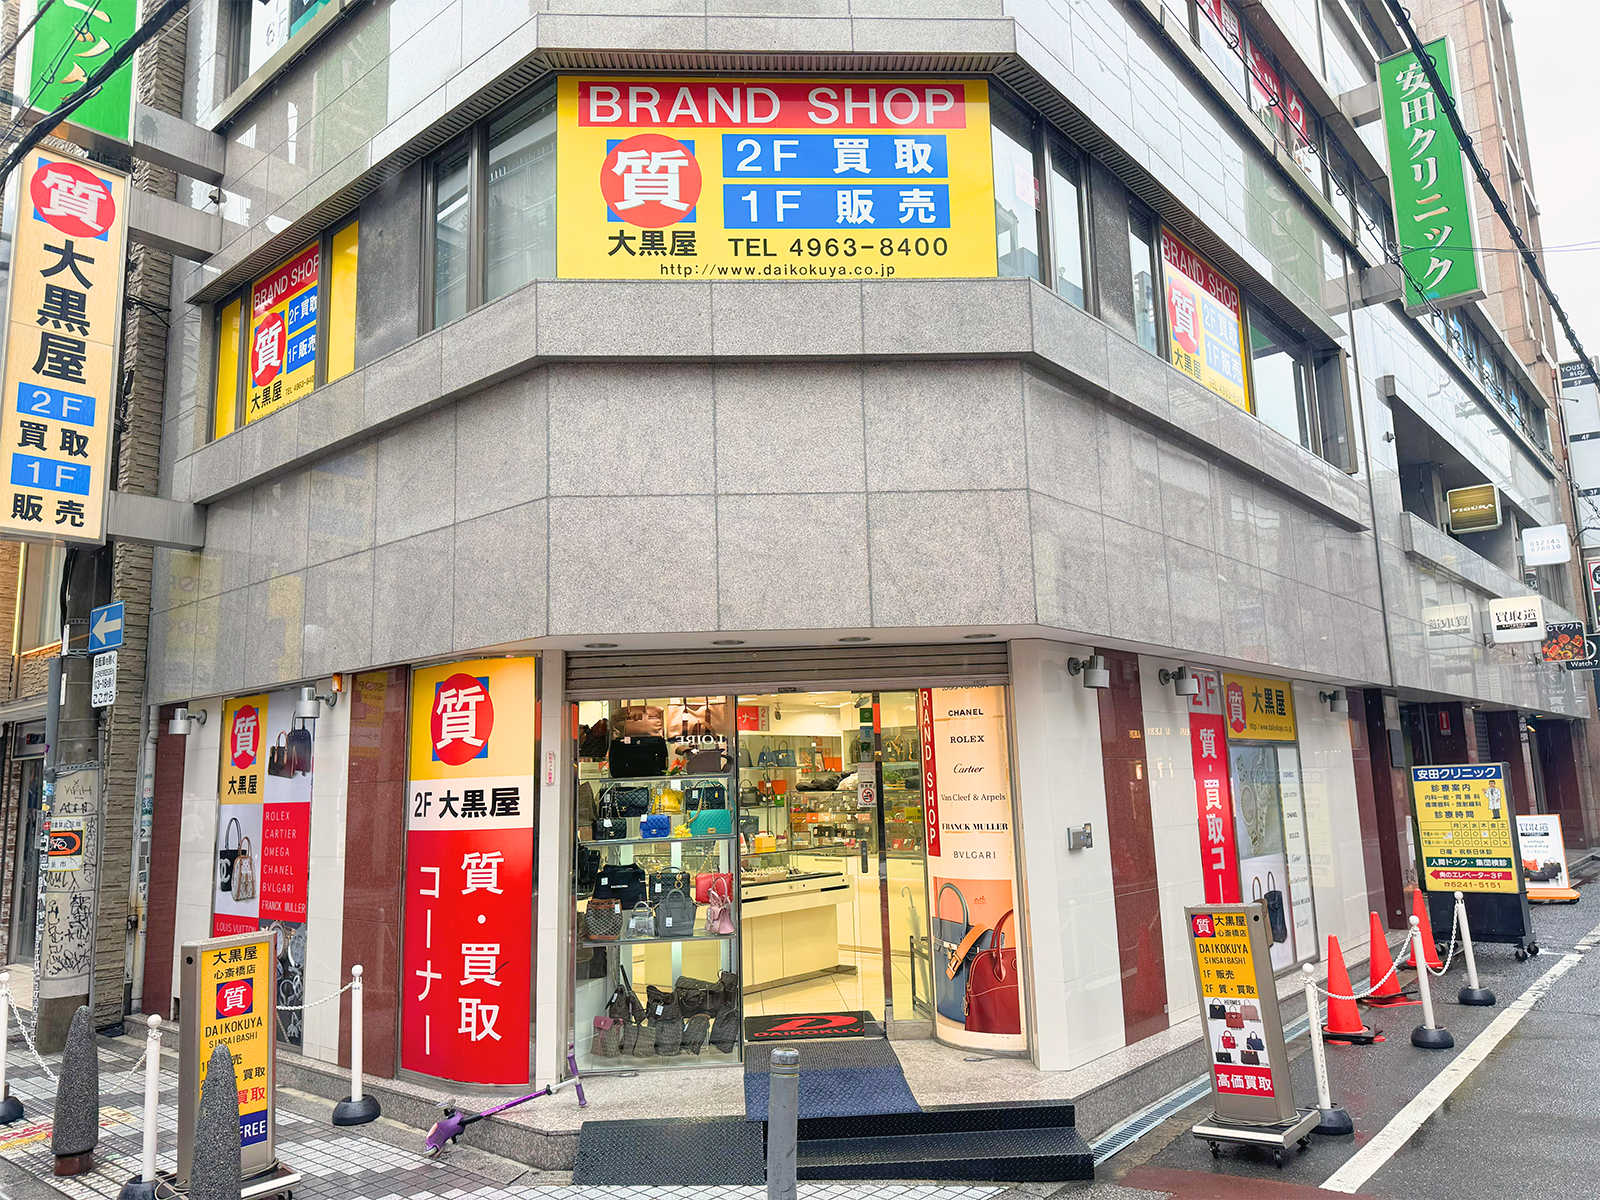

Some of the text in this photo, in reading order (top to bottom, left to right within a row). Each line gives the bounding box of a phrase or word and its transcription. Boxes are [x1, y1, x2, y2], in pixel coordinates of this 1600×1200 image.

[588, 86, 955, 125] BRAND SHOP
[736, 137, 935, 175] 2F 買取
[611, 148, 691, 212] 質
[1395, 61, 1454, 290] 安田クリニック
[41, 169, 107, 232] 質
[741, 187, 937, 225] 1F 販売
[607, 229, 698, 258] 大黒屋
[728, 236, 949, 257] TEL 4963-8400
[253, 253, 319, 311] BRAND SHOP
[660, 263, 896, 277] http://www.daikokuya.co.jp
[1162, 233, 1238, 313] BRAND SHOP
[32, 239, 95, 385] 大黒屋
[288, 294, 318, 326] 2F 買取
[1171, 286, 1197, 347] 質
[1203, 304, 1240, 348] 2F 買取
[254, 319, 282, 379] 質
[287, 333, 317, 364] 1F 販売
[1174, 348, 1202, 382] 大黒屋
[1206, 342, 1242, 384] 1F 販売
[31, 390, 83, 418] 2F
[251, 380, 282, 414] 大黒屋
[17, 419, 89, 459] 買取
[27, 461, 77, 488] 1F
[11, 493, 84, 528] 販売
[1191, 673, 1215, 707] 2F
[1251, 685, 1287, 716] 大黒屋
[434, 685, 485, 750] 質
[947, 708, 984, 717] CHANEL
[1228, 690, 1246, 723] 質
[234, 714, 257, 759] 質
[950, 735, 985, 744] ROLEX
[953, 763, 985, 774] Cartier
[1417, 767, 1496, 780] 安田クリニック
[227, 774, 258, 796] 大黒屋
[941, 793, 952, 801] Van
[952, 793, 971, 801] Cleef
[980, 792, 1006, 802] Arpels
[1431, 783, 1471, 793] 診療案内
[414, 787, 520, 819] 2F 大黒屋
[927, 771, 936, 844] SHOP
[265, 811, 291, 821] ROLEX
[941, 822, 1009, 831] FRANCK MULLER
[264, 828, 297, 839] CARTIER
[263, 846, 290, 857] OMEGA
[953, 850, 997, 860] BVLGARI
[263, 864, 294, 876] CHANEL
[262, 882, 295, 894] BVLGARI
[1451, 881, 1502, 889] 6241-5151
[261, 900, 306, 914] FRANCK MULLER
[216, 921, 232, 933] LOUIS
[1196, 918, 1211, 934] 質
[1214, 915, 1246, 927] 大黒屋
[1217, 929, 1247, 937] 心斎橋店
[212, 945, 258, 966] 大黒屋
[457, 850, 504, 1042] 質・買取
[1199, 943, 1249, 954] DAIKOKUYA
[213, 963, 257, 980] 心斎橋店
[415, 866, 442, 1056] コーナー
[1204, 956, 1246, 965] SINSAIBASHI
[1203, 969, 1234, 980] 1F 販売
[223, 985, 247, 1012] 質
[1205, 984, 1213, 993] 2F
[205, 1016, 263, 1039] DAIKOKUYA
[209, 1031, 258, 1049] SINSAIBASHI
[1216, 1072, 1273, 1092] 高価買取
[240, 1119, 267, 1138] FREE
